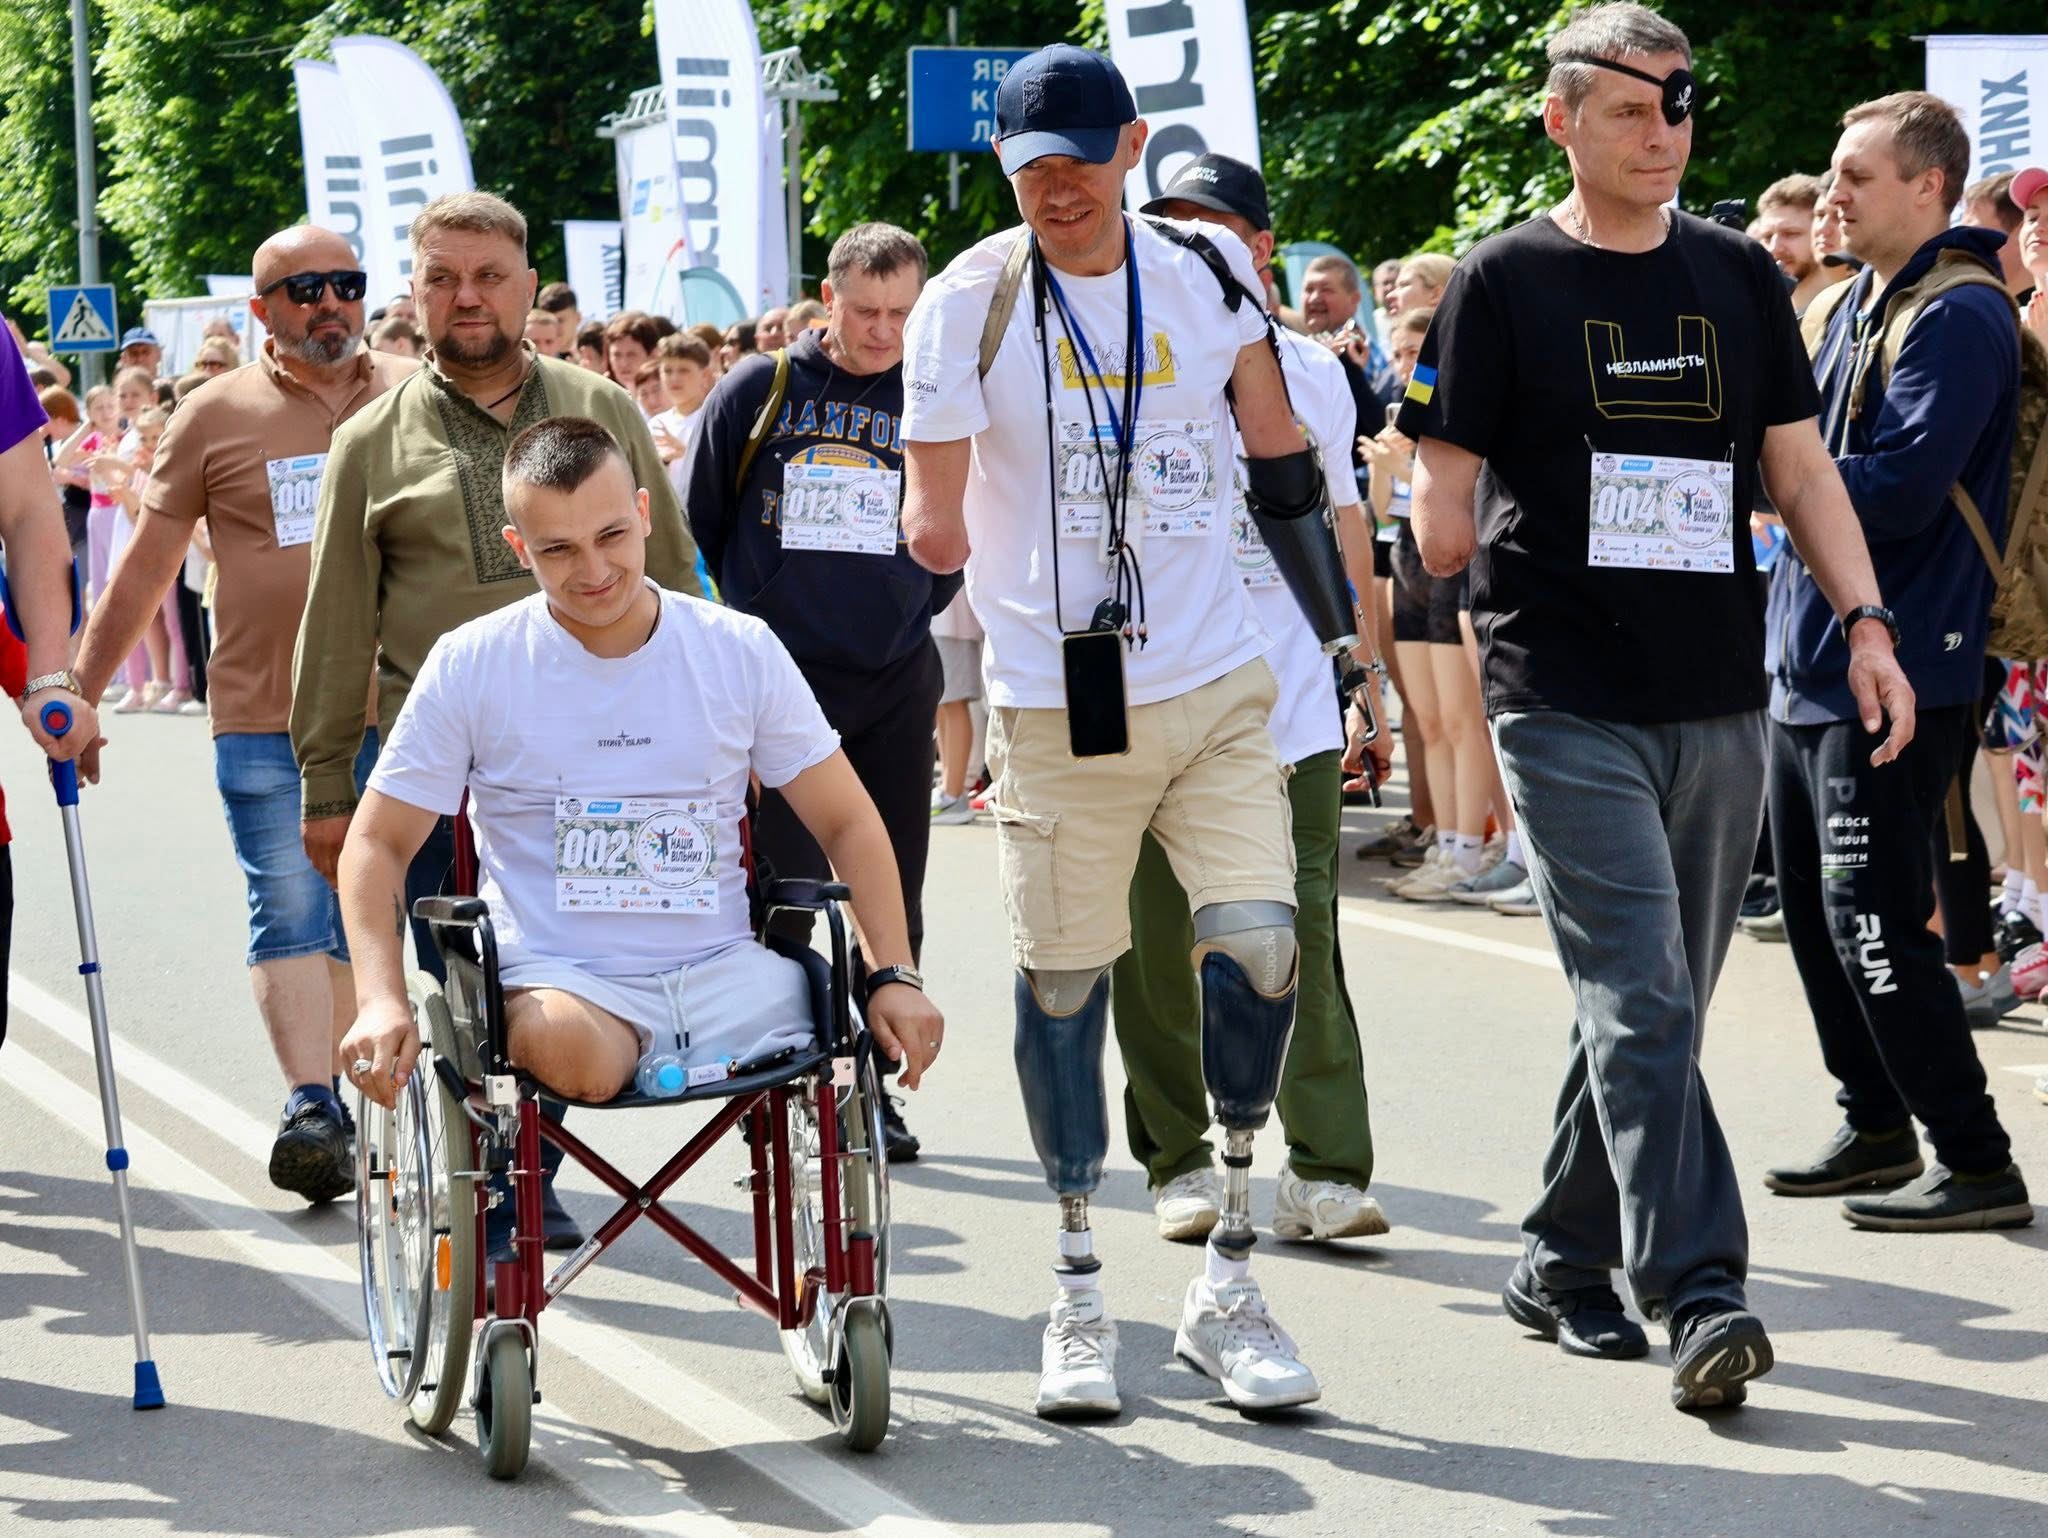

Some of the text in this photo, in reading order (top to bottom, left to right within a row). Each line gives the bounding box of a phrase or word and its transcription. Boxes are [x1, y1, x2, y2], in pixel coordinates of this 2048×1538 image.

[1606, 354, 1706, 376] НЕЗЛАМНІСТЬ
[787, 487, 838, 519] 012
[1596, 485, 1658, 528] 004
[563, 827, 631, 869] 002
[1837, 834, 1869, 845] YOUR
[1856, 913, 1898, 995] RUN
